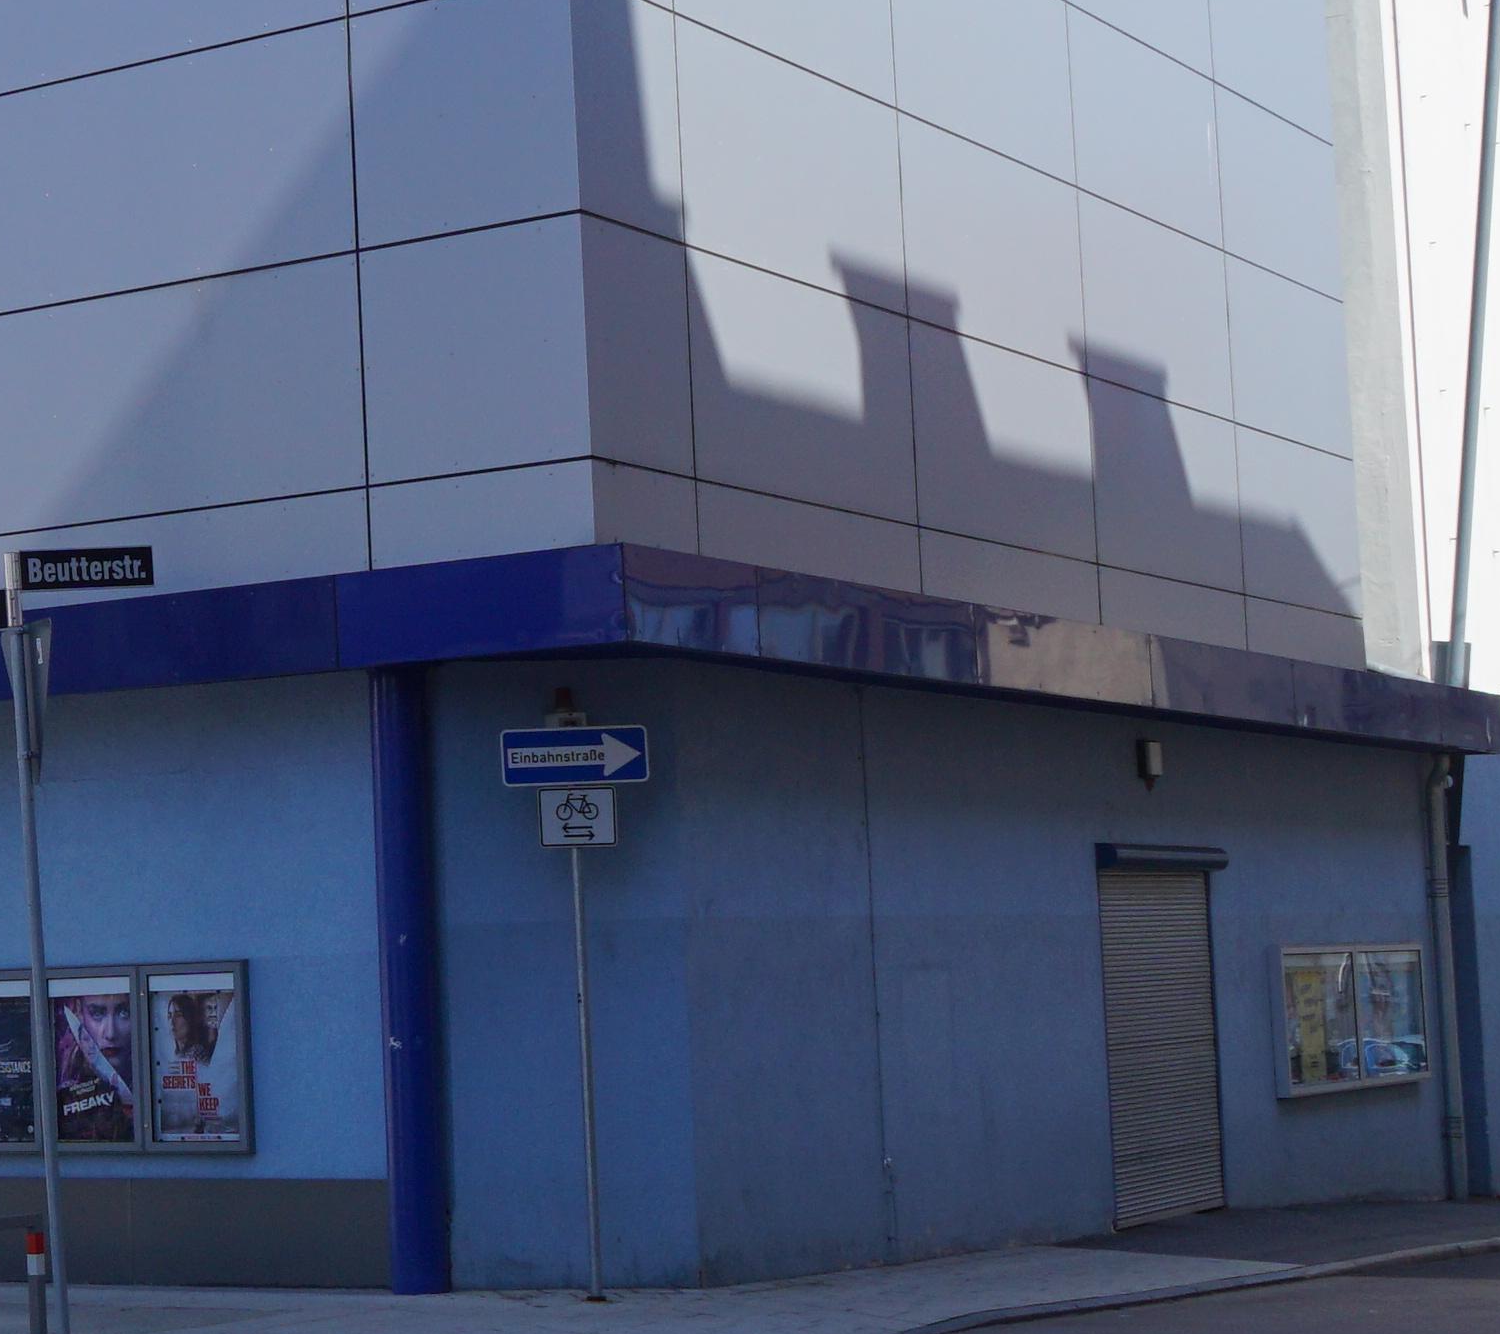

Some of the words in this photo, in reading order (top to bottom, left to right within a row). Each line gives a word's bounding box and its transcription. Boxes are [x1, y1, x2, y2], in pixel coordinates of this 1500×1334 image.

[28, 554, 146, 583] Beutterstr.
[511, 748, 606, 765] Einbahnstraße
[180, 1060, 196, 1074] THE
[162, 1075, 196, 1090] SECRETS
[197, 1082, 212, 1097] WE
[63, 1091, 114, 1116] FREAKY
[199, 1097, 219, 1111] KEEP
